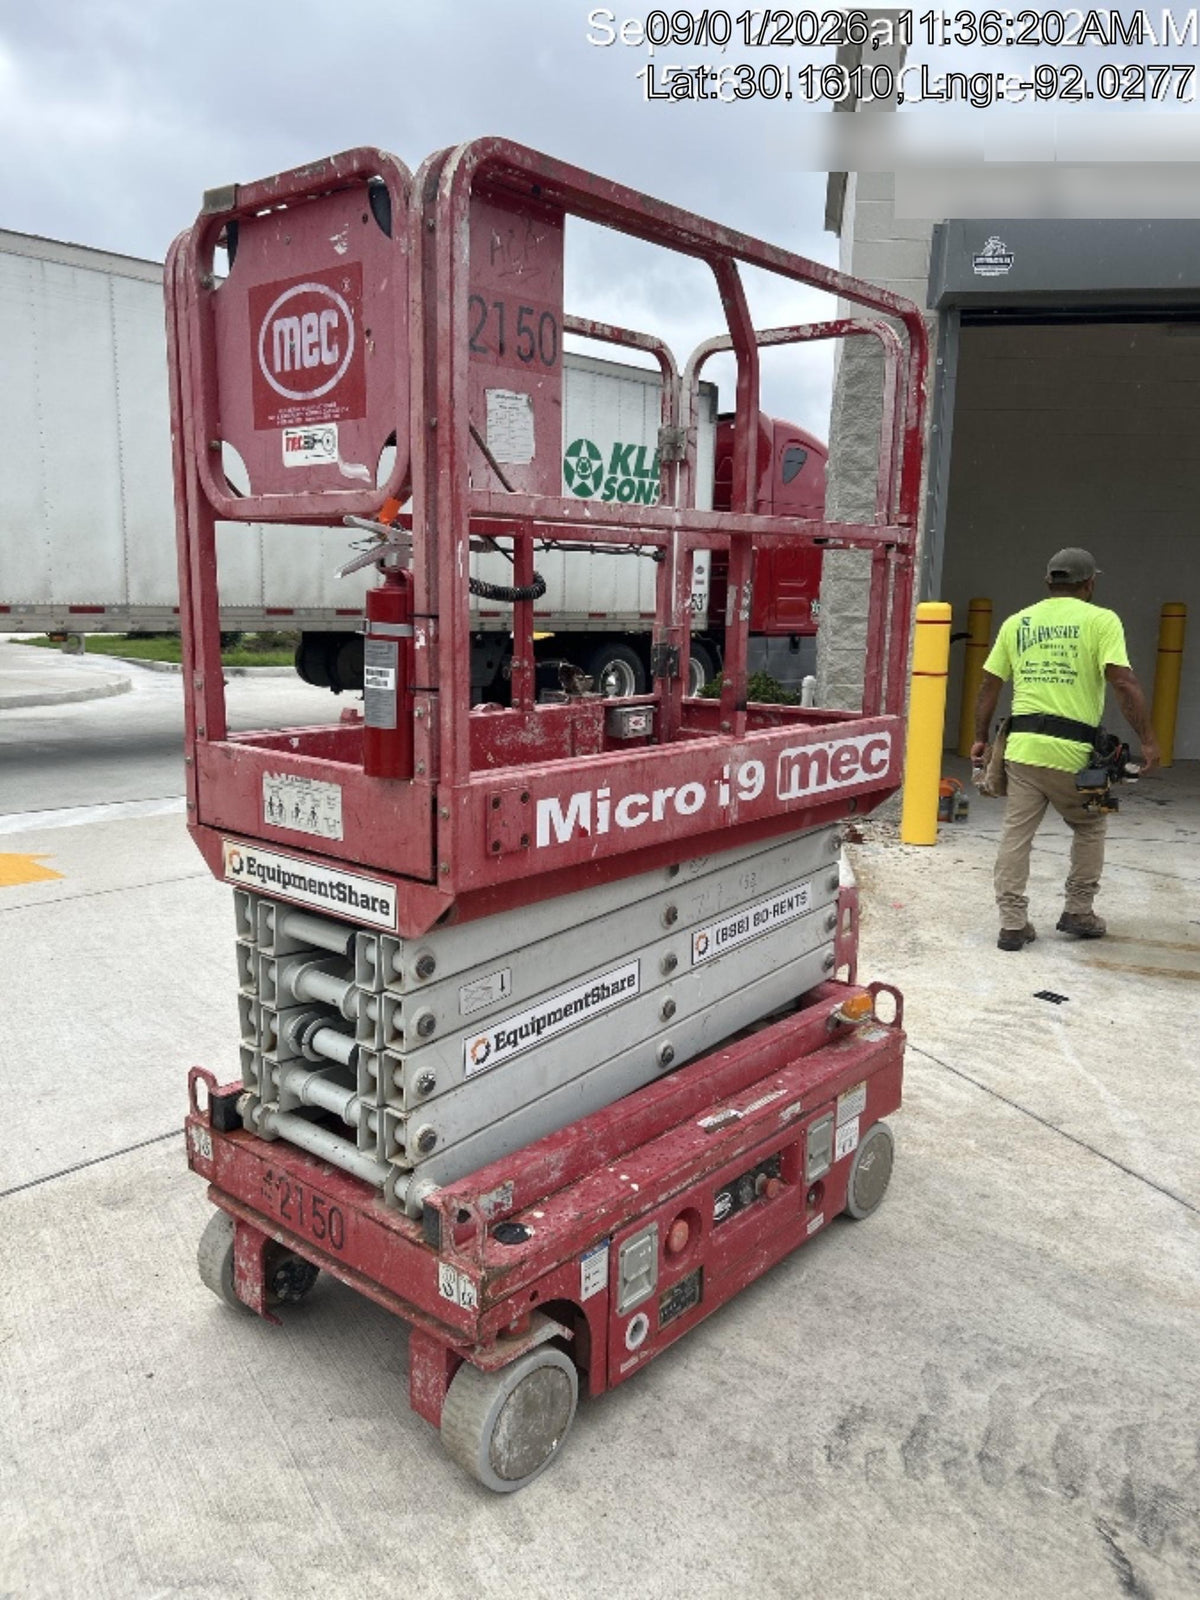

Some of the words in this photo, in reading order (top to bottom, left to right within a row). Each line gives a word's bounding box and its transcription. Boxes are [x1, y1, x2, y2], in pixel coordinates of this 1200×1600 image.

[467, 293, 558, 366] 2150
[536, 781, 706, 848] Micro
[714, 760, 765, 808] i9
[246, 856, 390, 916] EquipmentShare
[494, 973, 636, 1052] EquipmentShare
